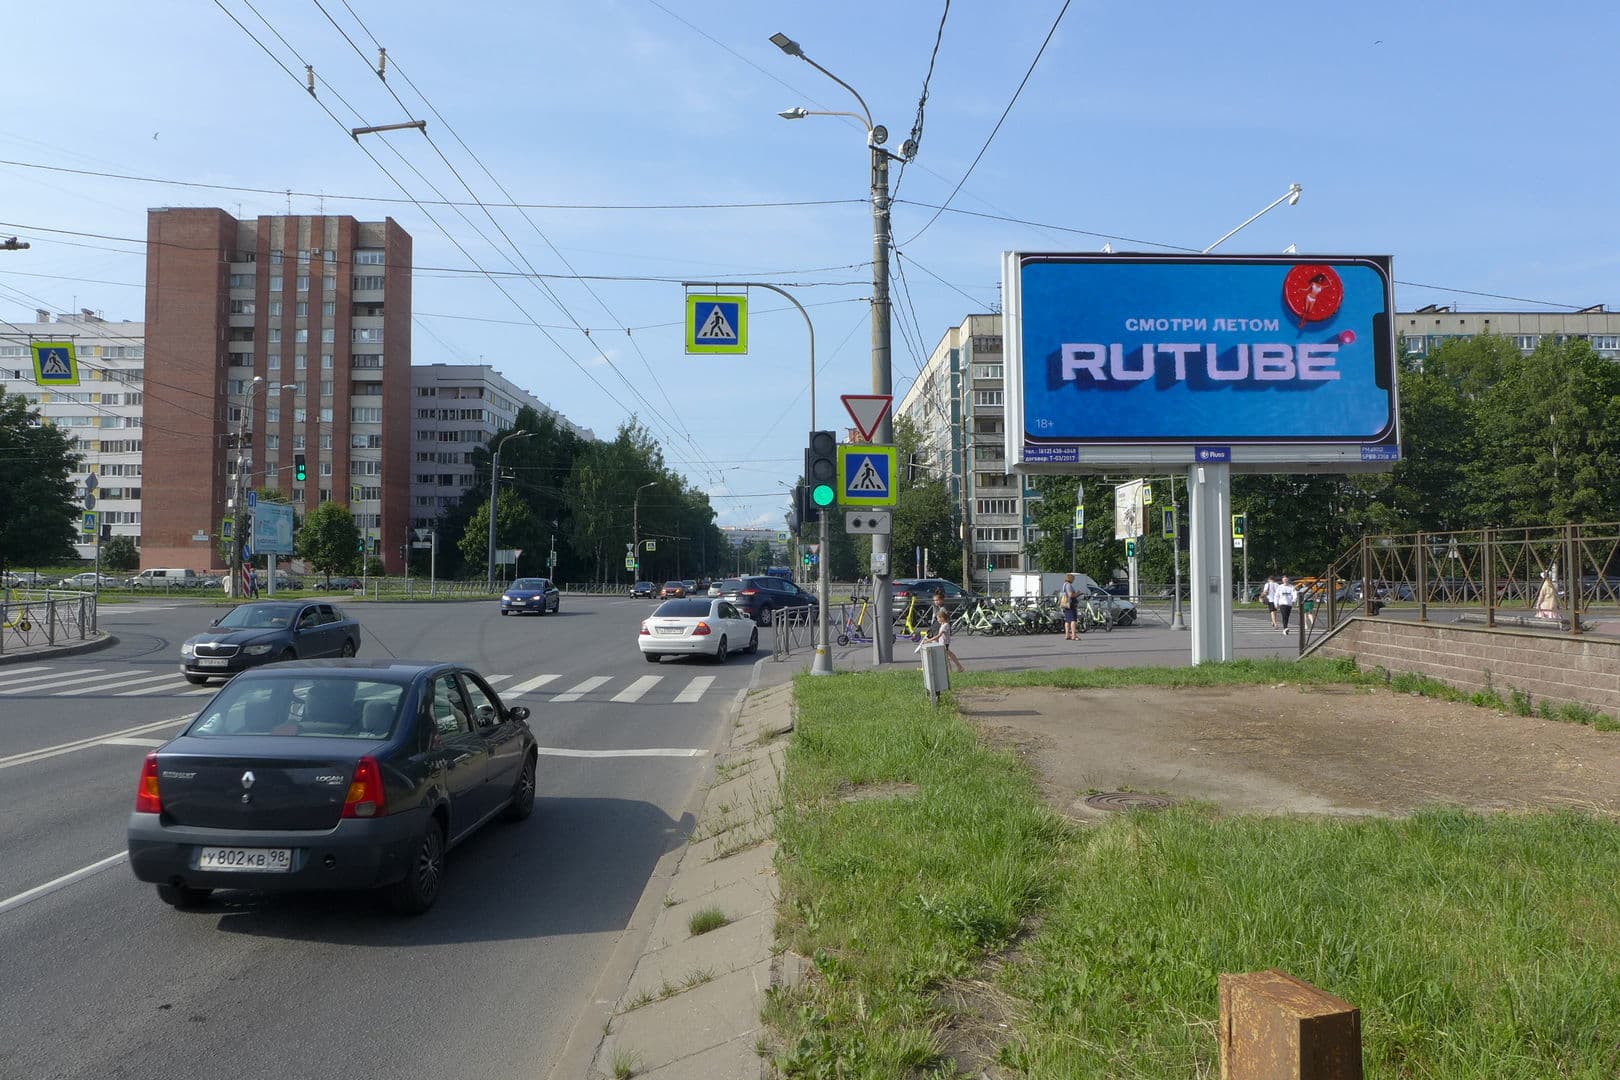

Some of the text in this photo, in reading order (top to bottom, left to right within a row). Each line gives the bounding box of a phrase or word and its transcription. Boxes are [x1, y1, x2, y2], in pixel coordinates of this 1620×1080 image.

[1125, 318, 1280, 332] СМОТРИ ЛЕТОМ
[1061, 343, 1341, 381] RUTUBE
[1035, 418, 1055, 429] 18+
